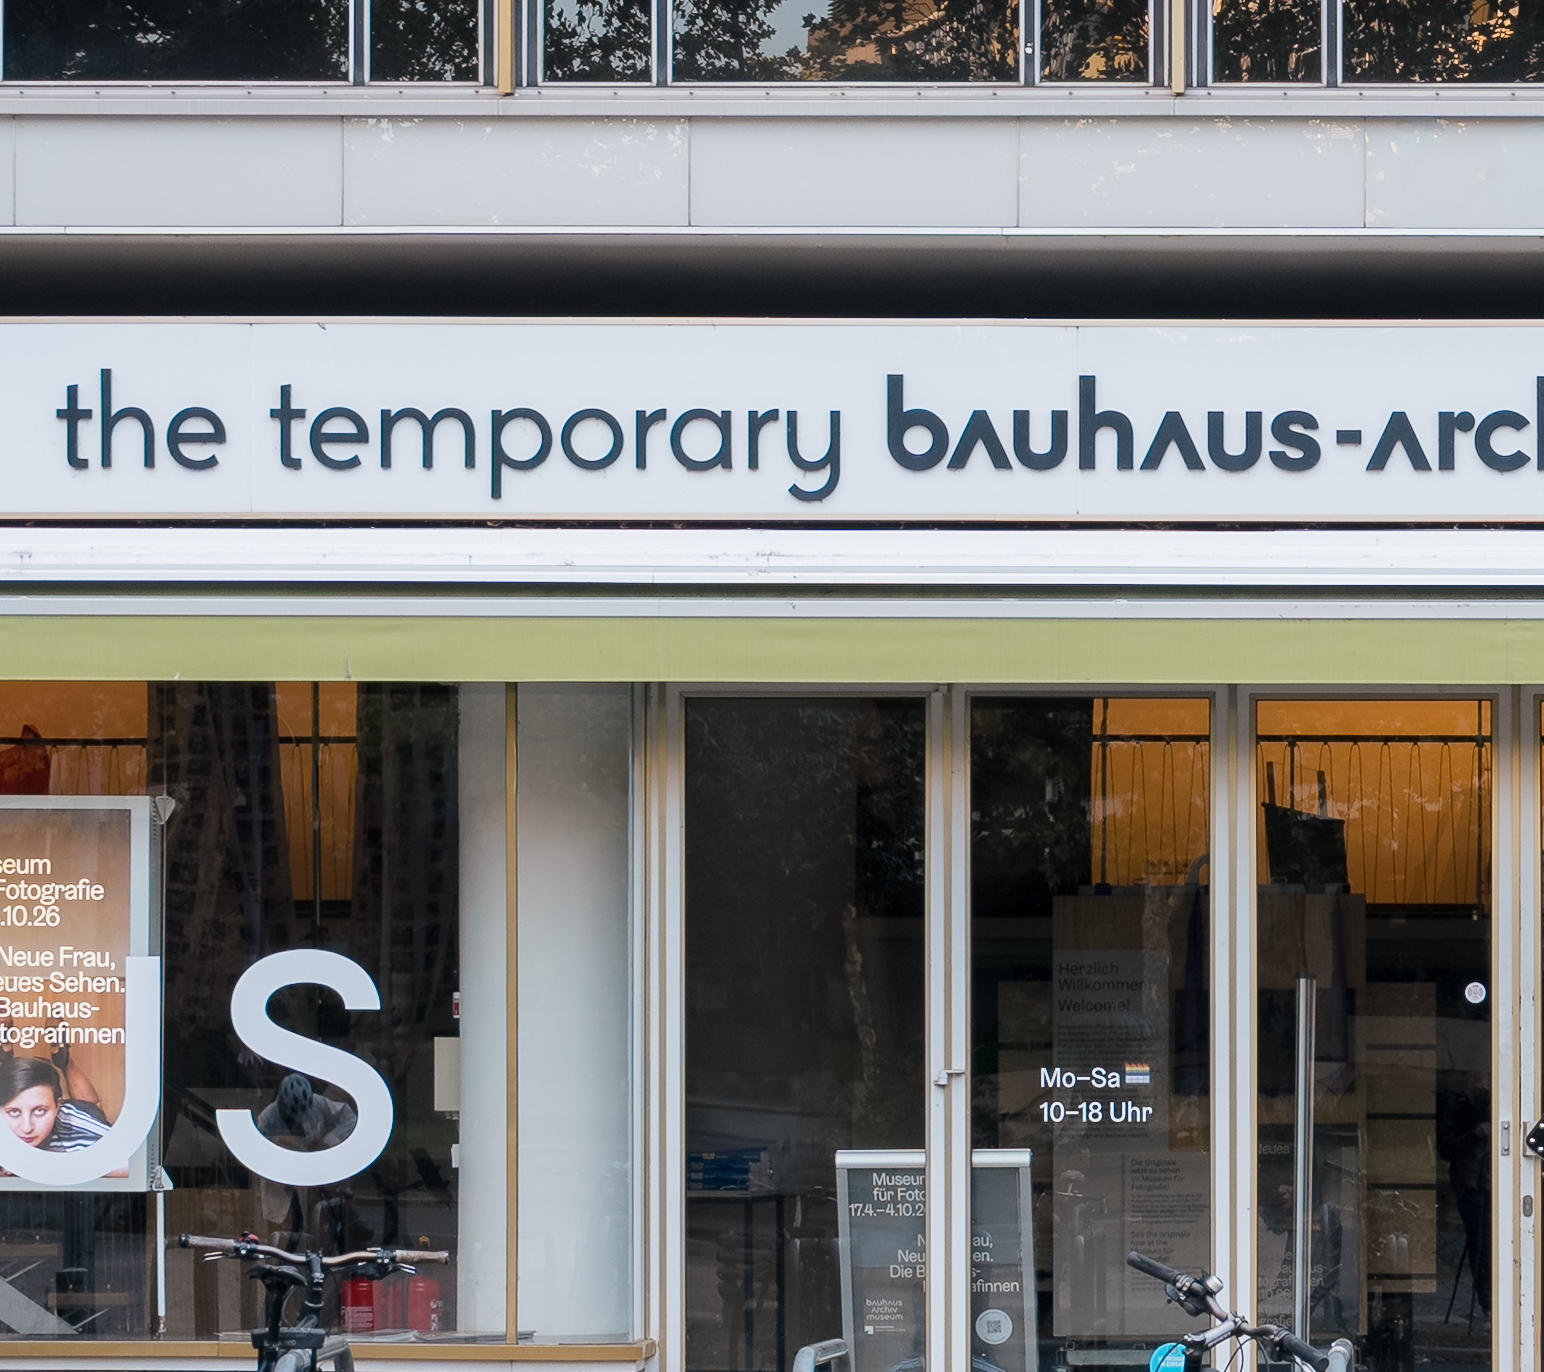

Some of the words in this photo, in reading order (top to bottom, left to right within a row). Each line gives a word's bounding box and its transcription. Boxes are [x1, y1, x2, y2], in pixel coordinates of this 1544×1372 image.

[56, 369, 226, 472] the
[270, 384, 840, 504] temporary
[60, 946, 116, 971] Frau,
[1058, 962, 1119, 975] Herzlich
[49, 972, 125, 993] Sehen.
[1058, 978, 1152, 991] Willkommen!
[1058, 999, 1131, 1012] Welcome!
[1110, 1101, 1153, 1123] Uhr
[873, 1188, 894, 1201] für
[849, 1204, 925, 1217] 17.4.–4.10.2
[898, 1249, 925, 1262] Neu
[890, 1265, 912, 1278] Die
